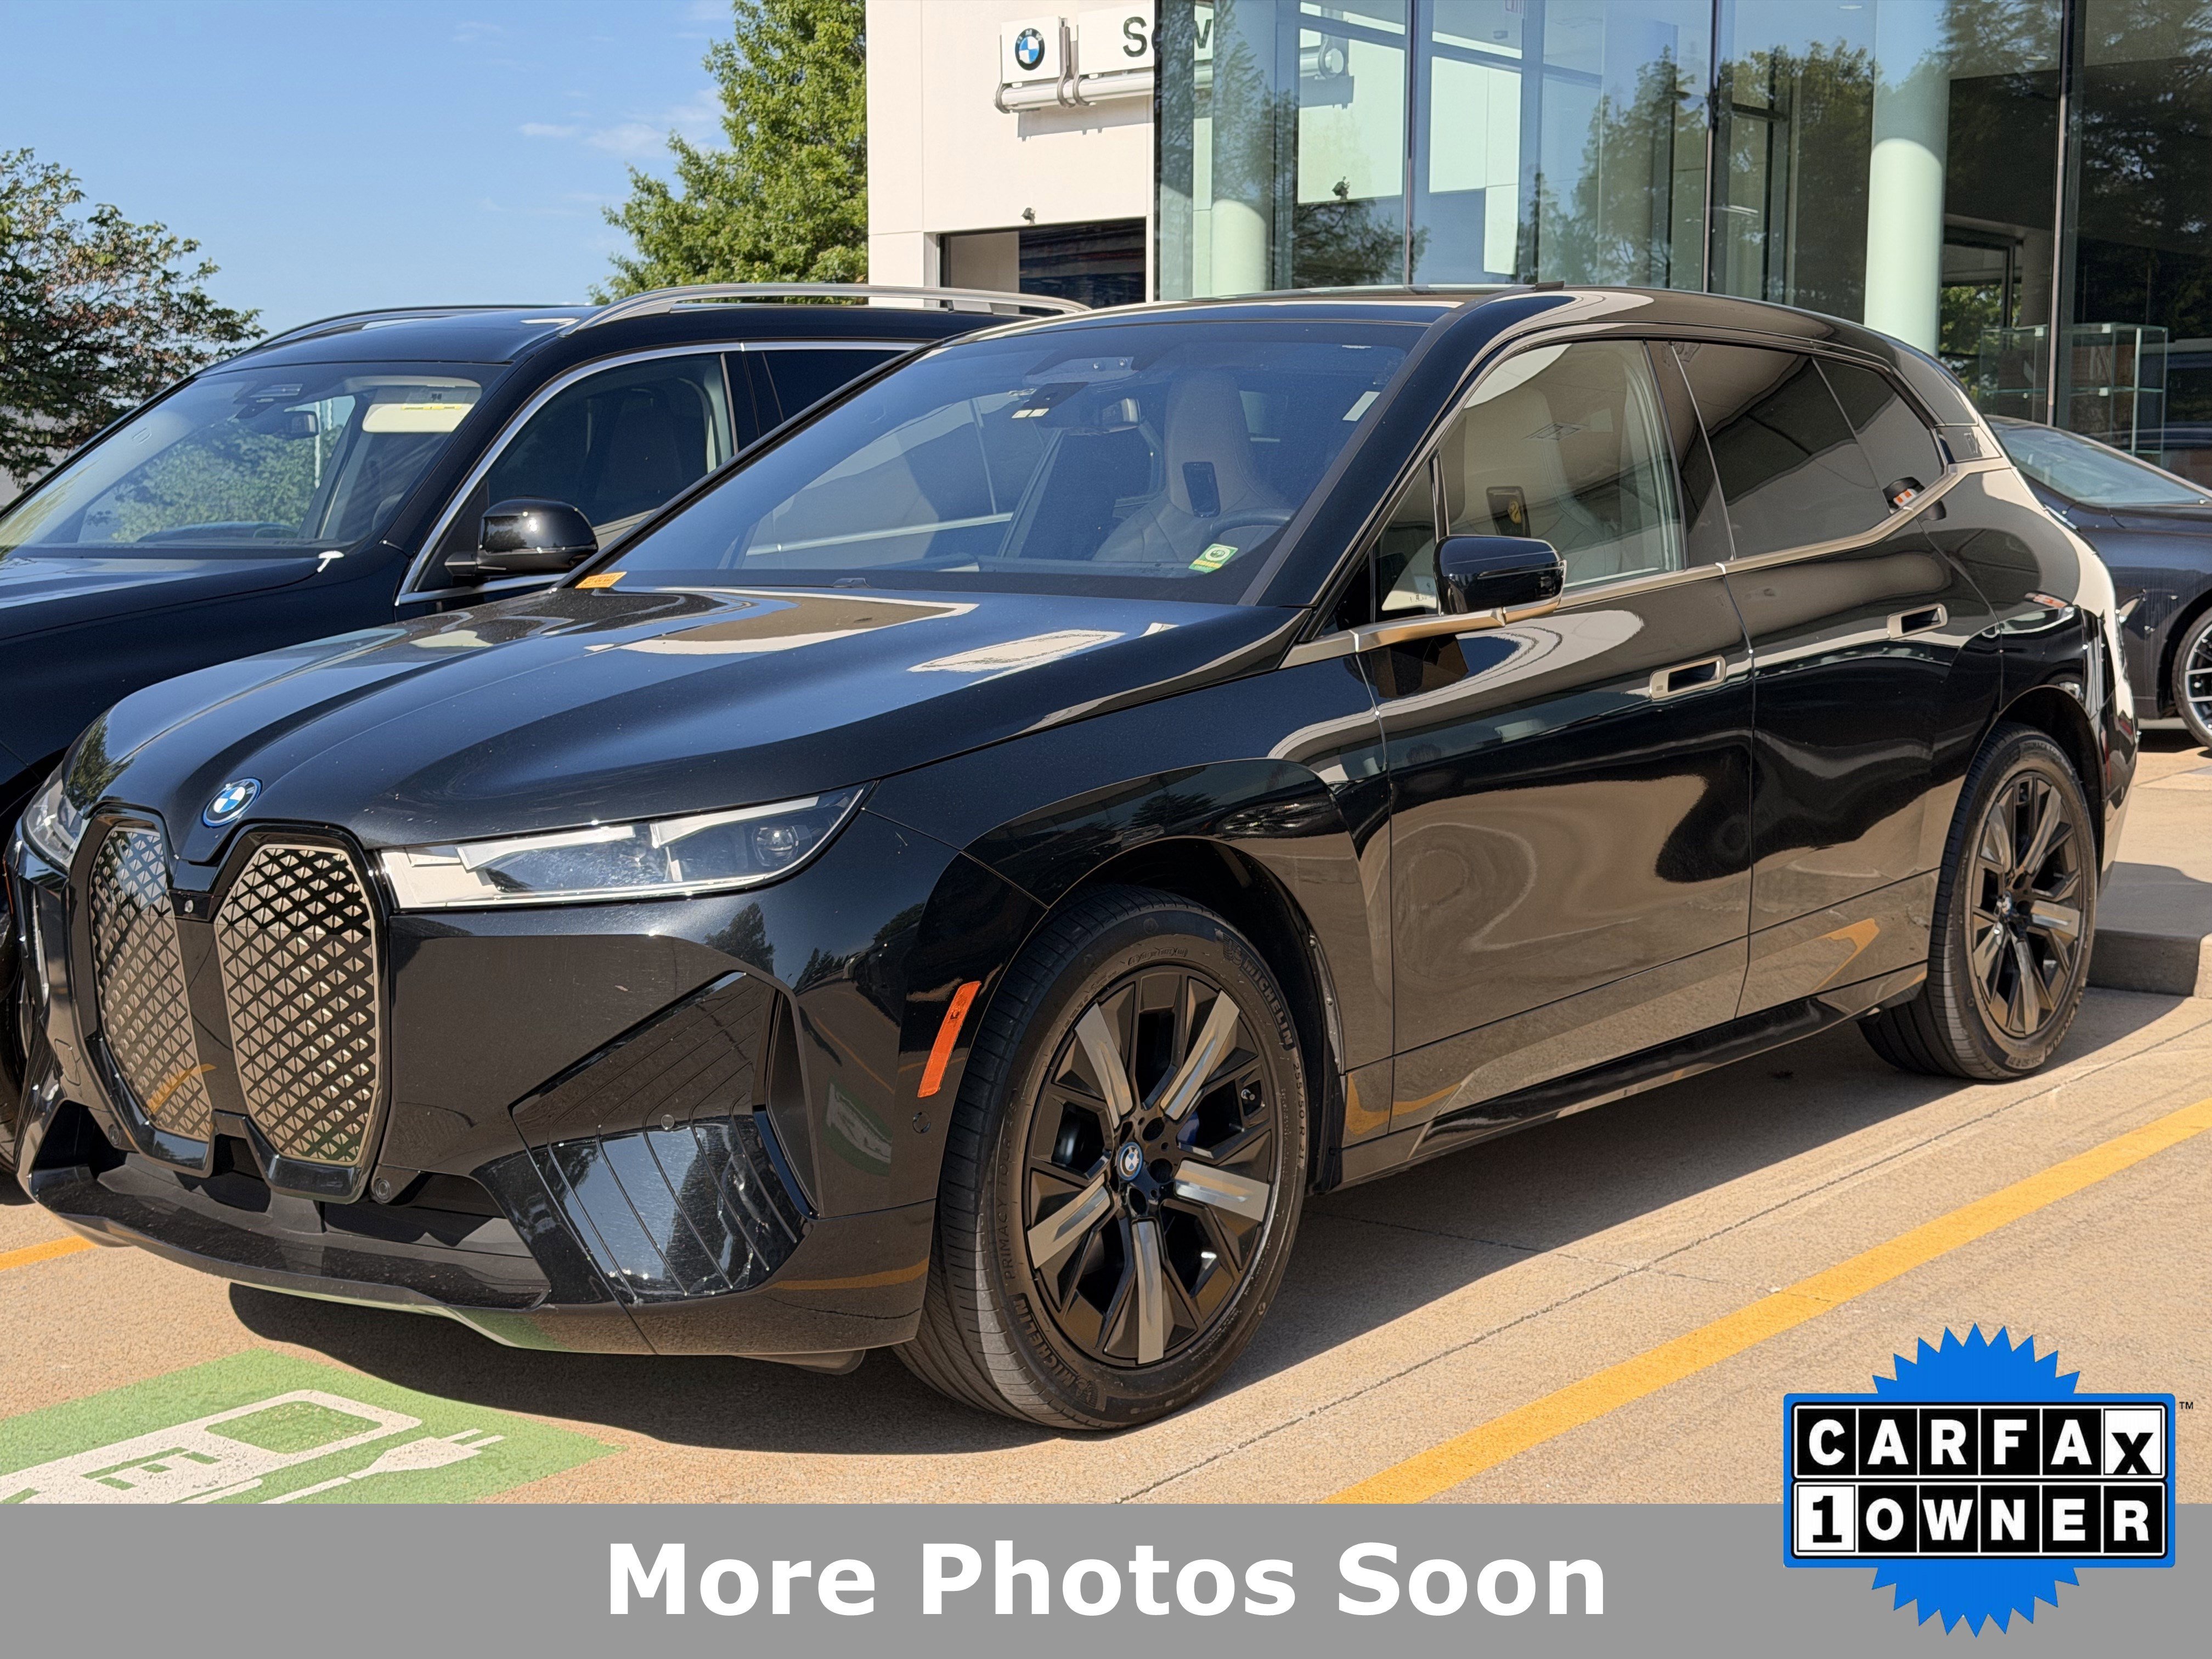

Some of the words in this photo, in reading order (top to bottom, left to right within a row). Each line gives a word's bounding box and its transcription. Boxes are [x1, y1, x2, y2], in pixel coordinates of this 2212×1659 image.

[1244, 958, 1294, 1045] MICHELIN
[1293, 1062, 1306, 1120] 255/50
[1298, 1144, 1305, 1160] 21
[1299, 1126, 1306, 1136] R
[996, 1198, 1015, 1280] PRIMACY
[1014, 1299, 1076, 1388] MICHELIN
